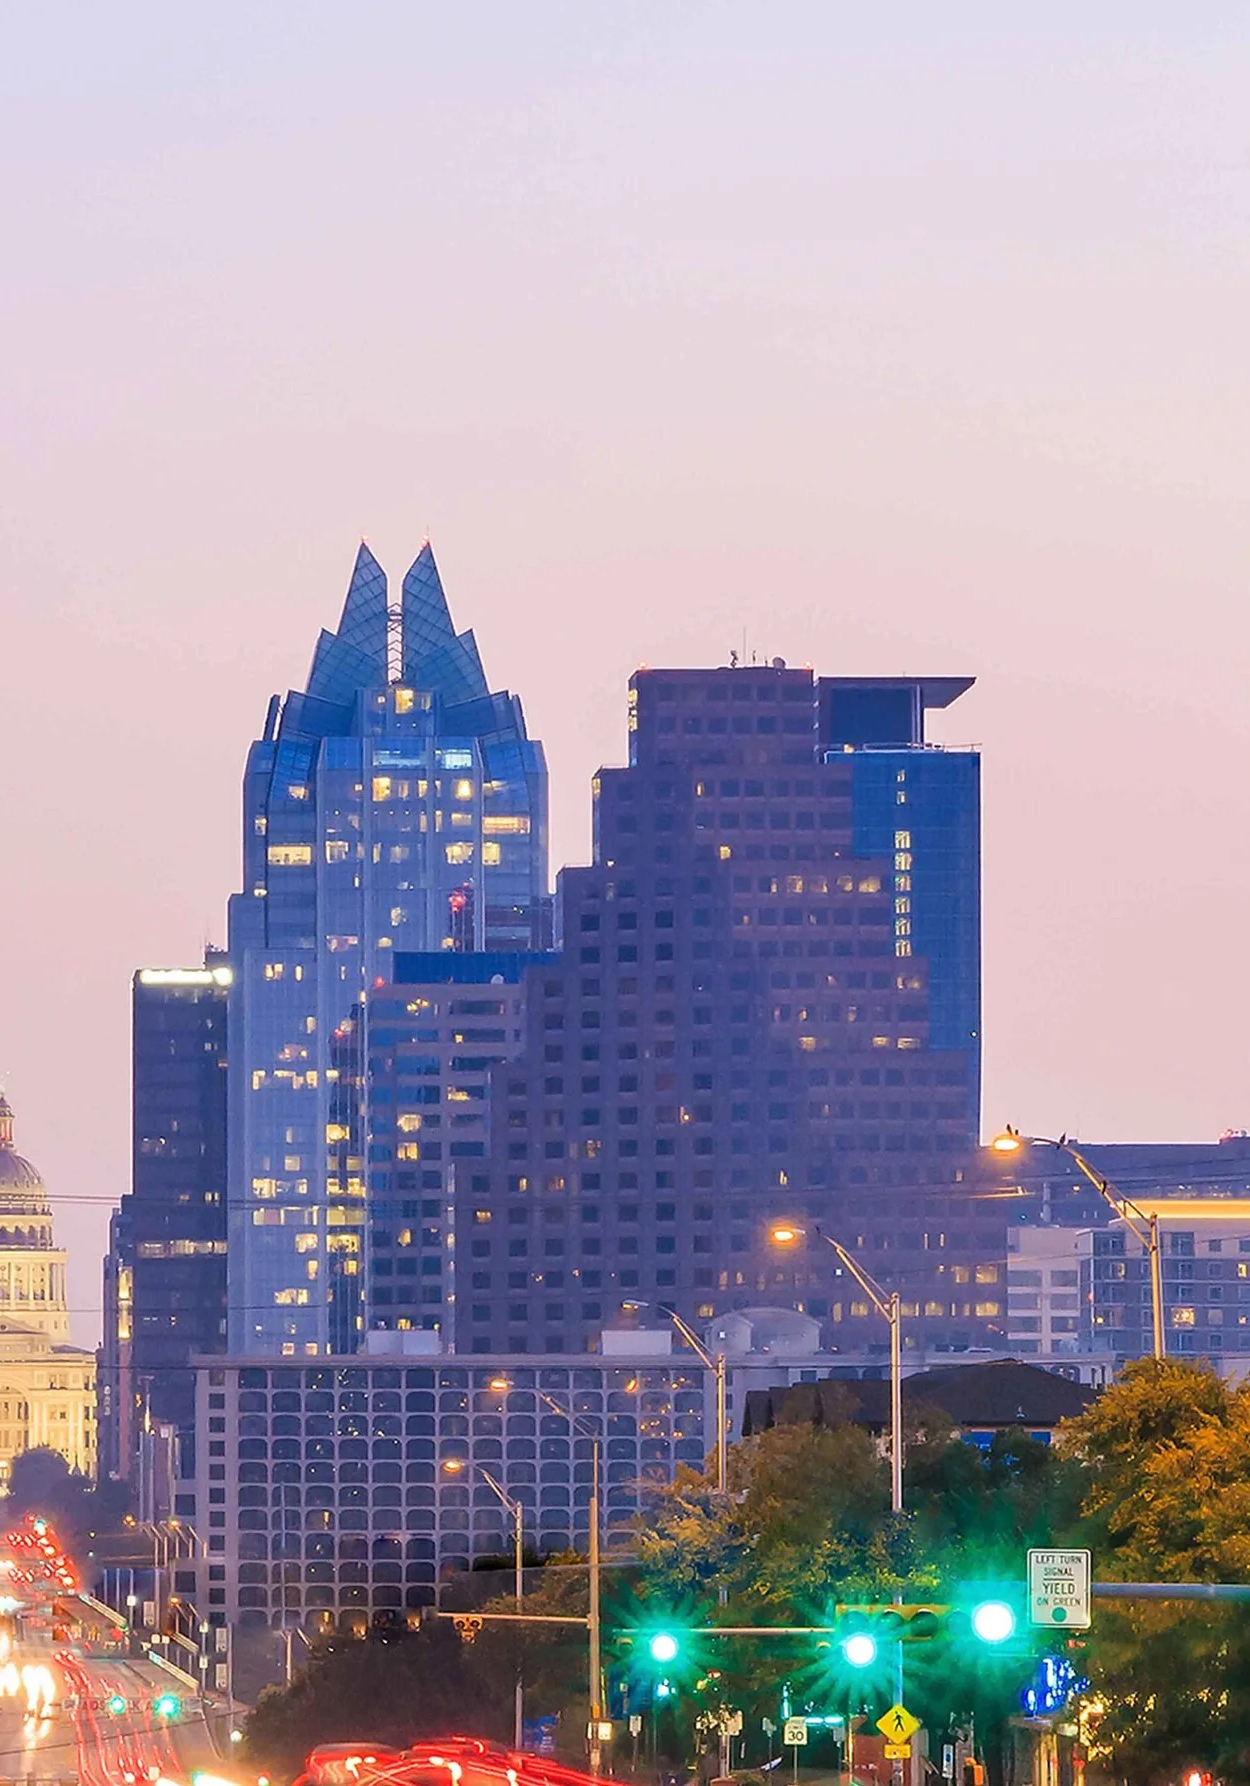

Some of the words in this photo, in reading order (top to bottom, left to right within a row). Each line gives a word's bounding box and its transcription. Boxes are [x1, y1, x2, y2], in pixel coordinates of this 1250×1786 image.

[1036, 1555, 1055, 1564] LEFT
[1060, 1555, 1082, 1564] TURN
[1044, 1567, 1074, 1576] SIGNAL
[1042, 1582, 1075, 1595] YIELD
[1037, 1597, 1049, 1606] ON
[1053, 1597, 1081, 1606] GREEN
[788, 1730, 804, 1741] 30
